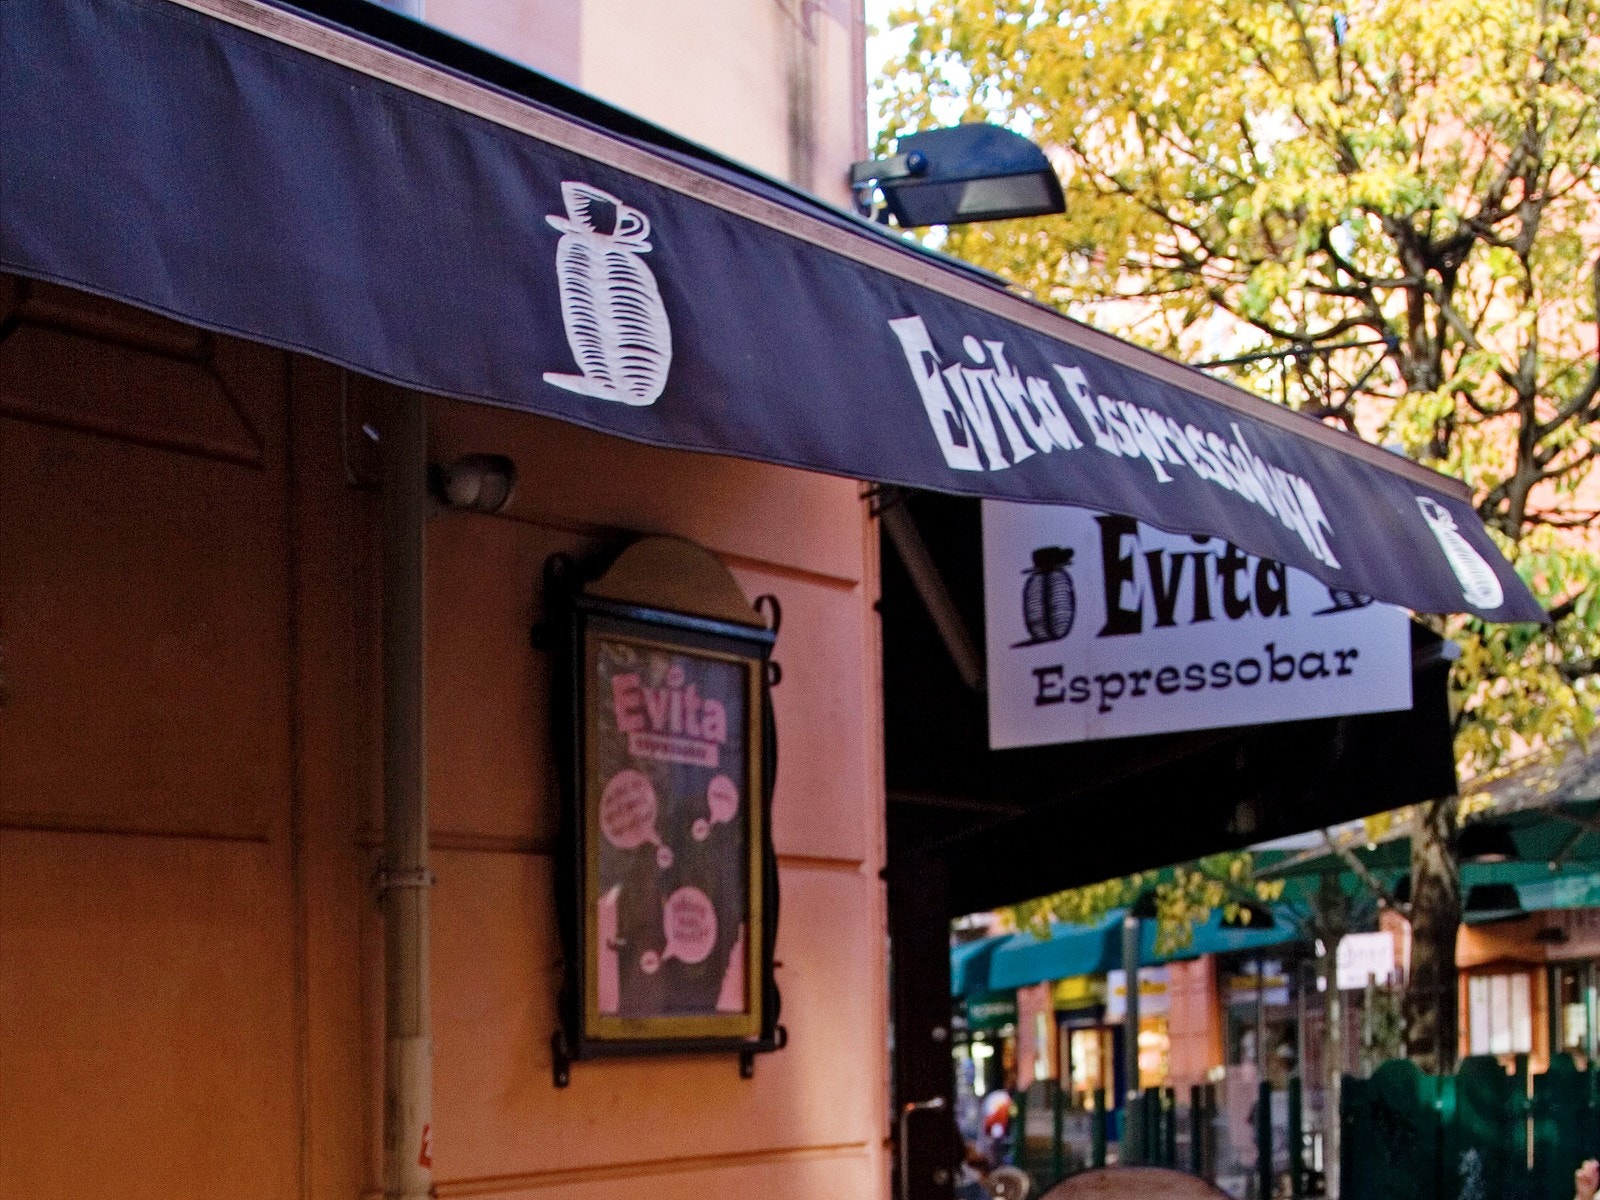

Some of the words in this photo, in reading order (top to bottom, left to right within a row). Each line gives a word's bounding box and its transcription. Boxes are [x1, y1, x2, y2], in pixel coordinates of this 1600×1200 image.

[887, 315, 1085, 472] Evita
[1051, 363, 1342, 570] Espressobar
[1094, 513, 1290, 638] Evita
[611, 663, 728, 745] Evita
[1031, 642, 1360, 714] Espressobar
